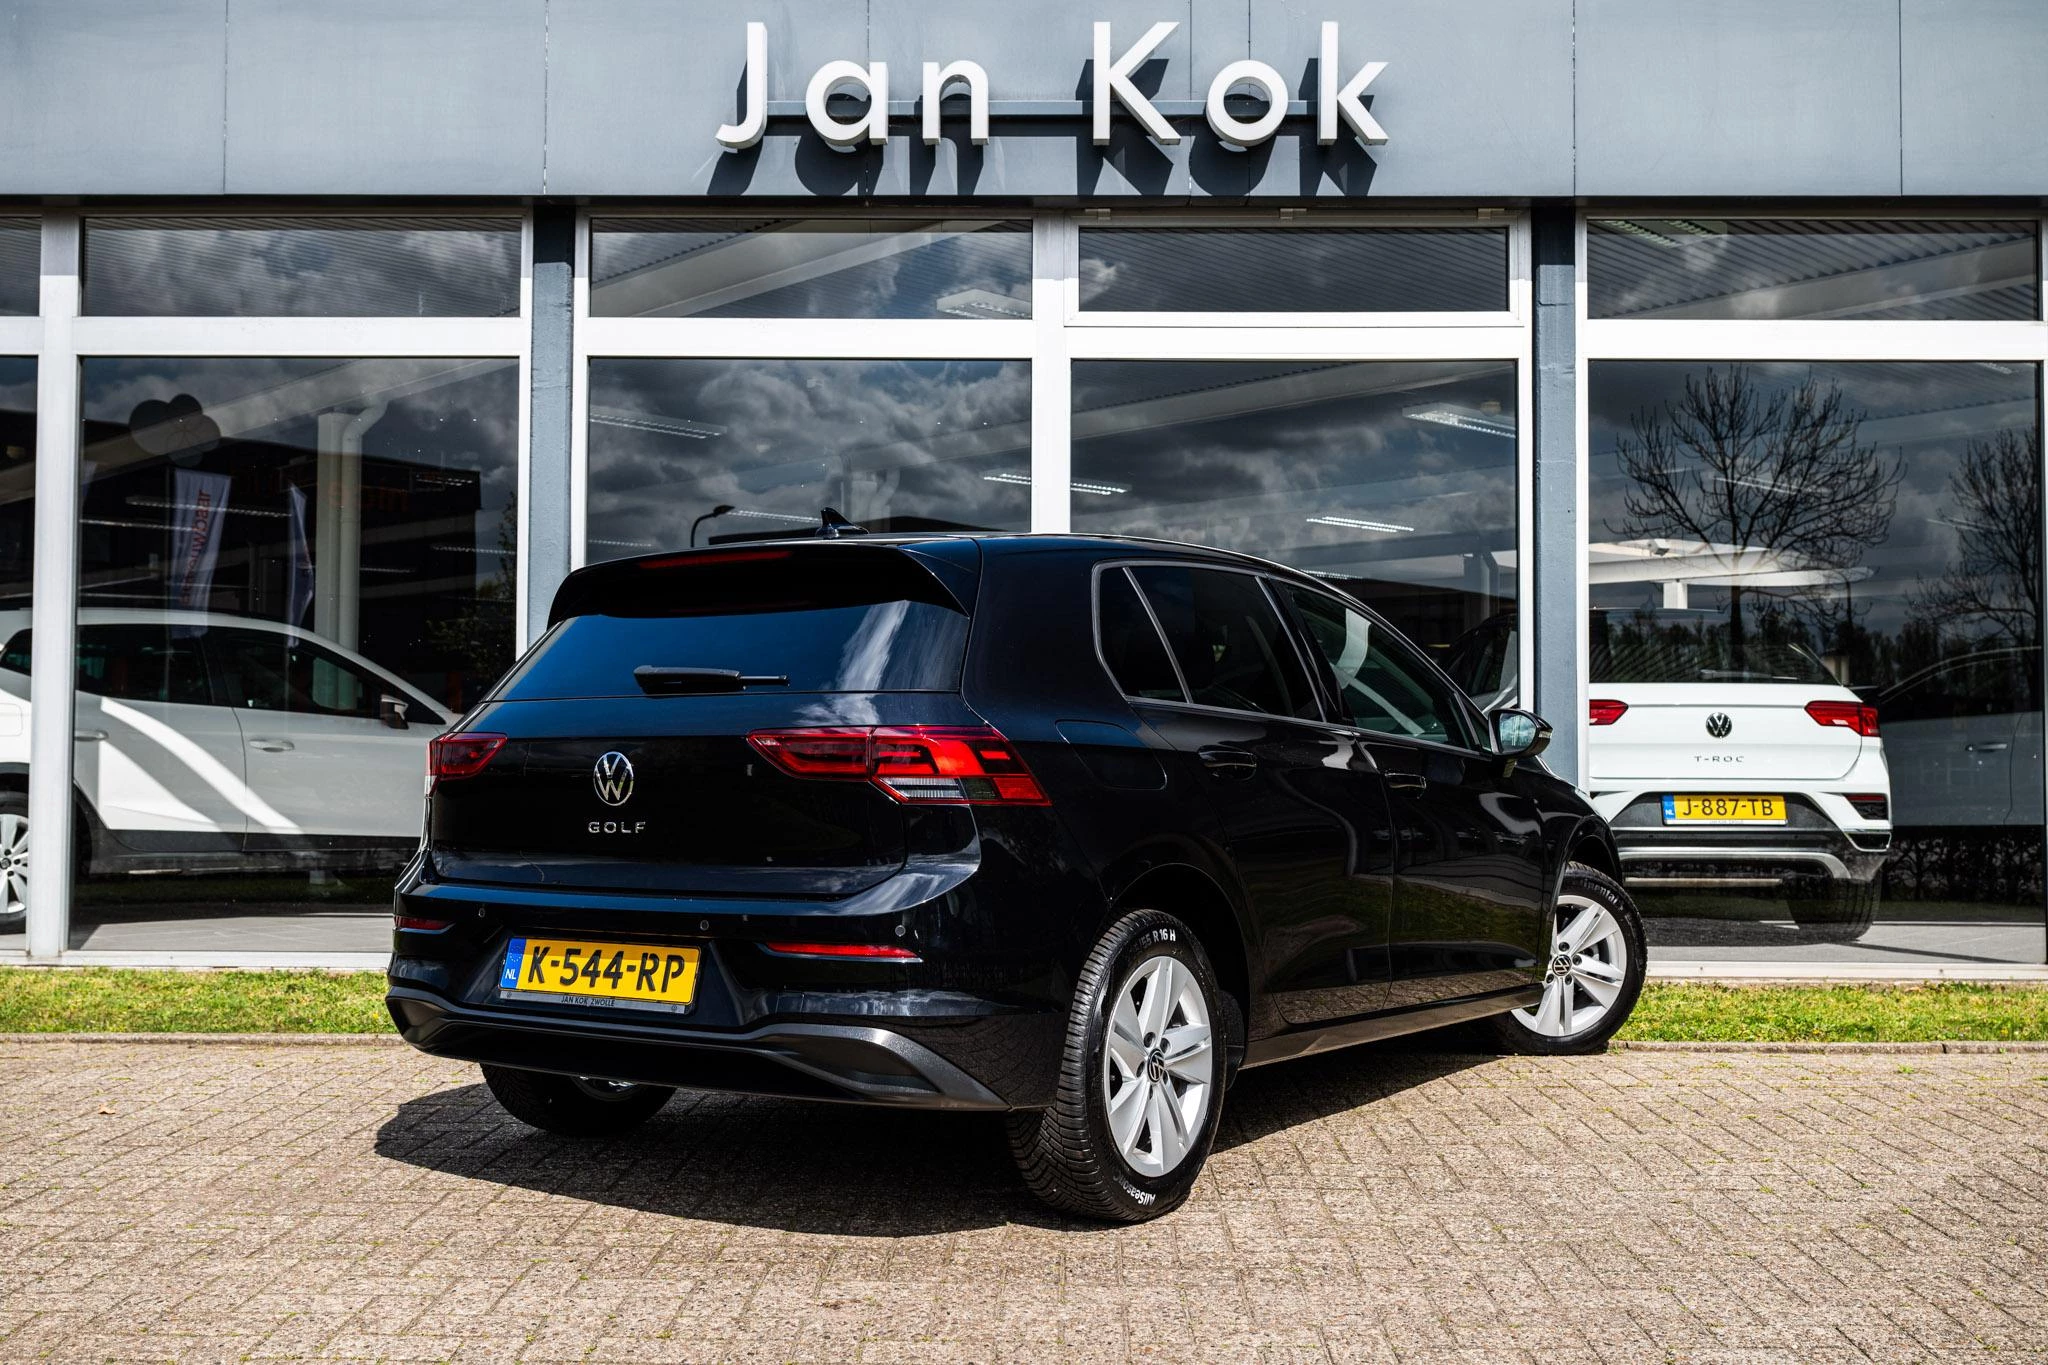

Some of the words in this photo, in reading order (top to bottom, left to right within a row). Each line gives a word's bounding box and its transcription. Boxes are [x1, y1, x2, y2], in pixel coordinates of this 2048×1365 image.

[715, 21, 990, 149] Jan
[1092, 21, 1389, 147] Kok
[1694, 755, 1745, 763] T-ROC
[593, 751, 634, 806] VW
[1682, 798, 1774, 816] J-887-TB
[588, 821, 646, 834] GOLF
[505, 968, 517, 980] NL
[528, 945, 685, 993] K-544-RP
[561, 995, 574, 1004] JAN
[574, 996, 589, 1005] KOK
[590, 997, 616, 1007] ZWOLLE
